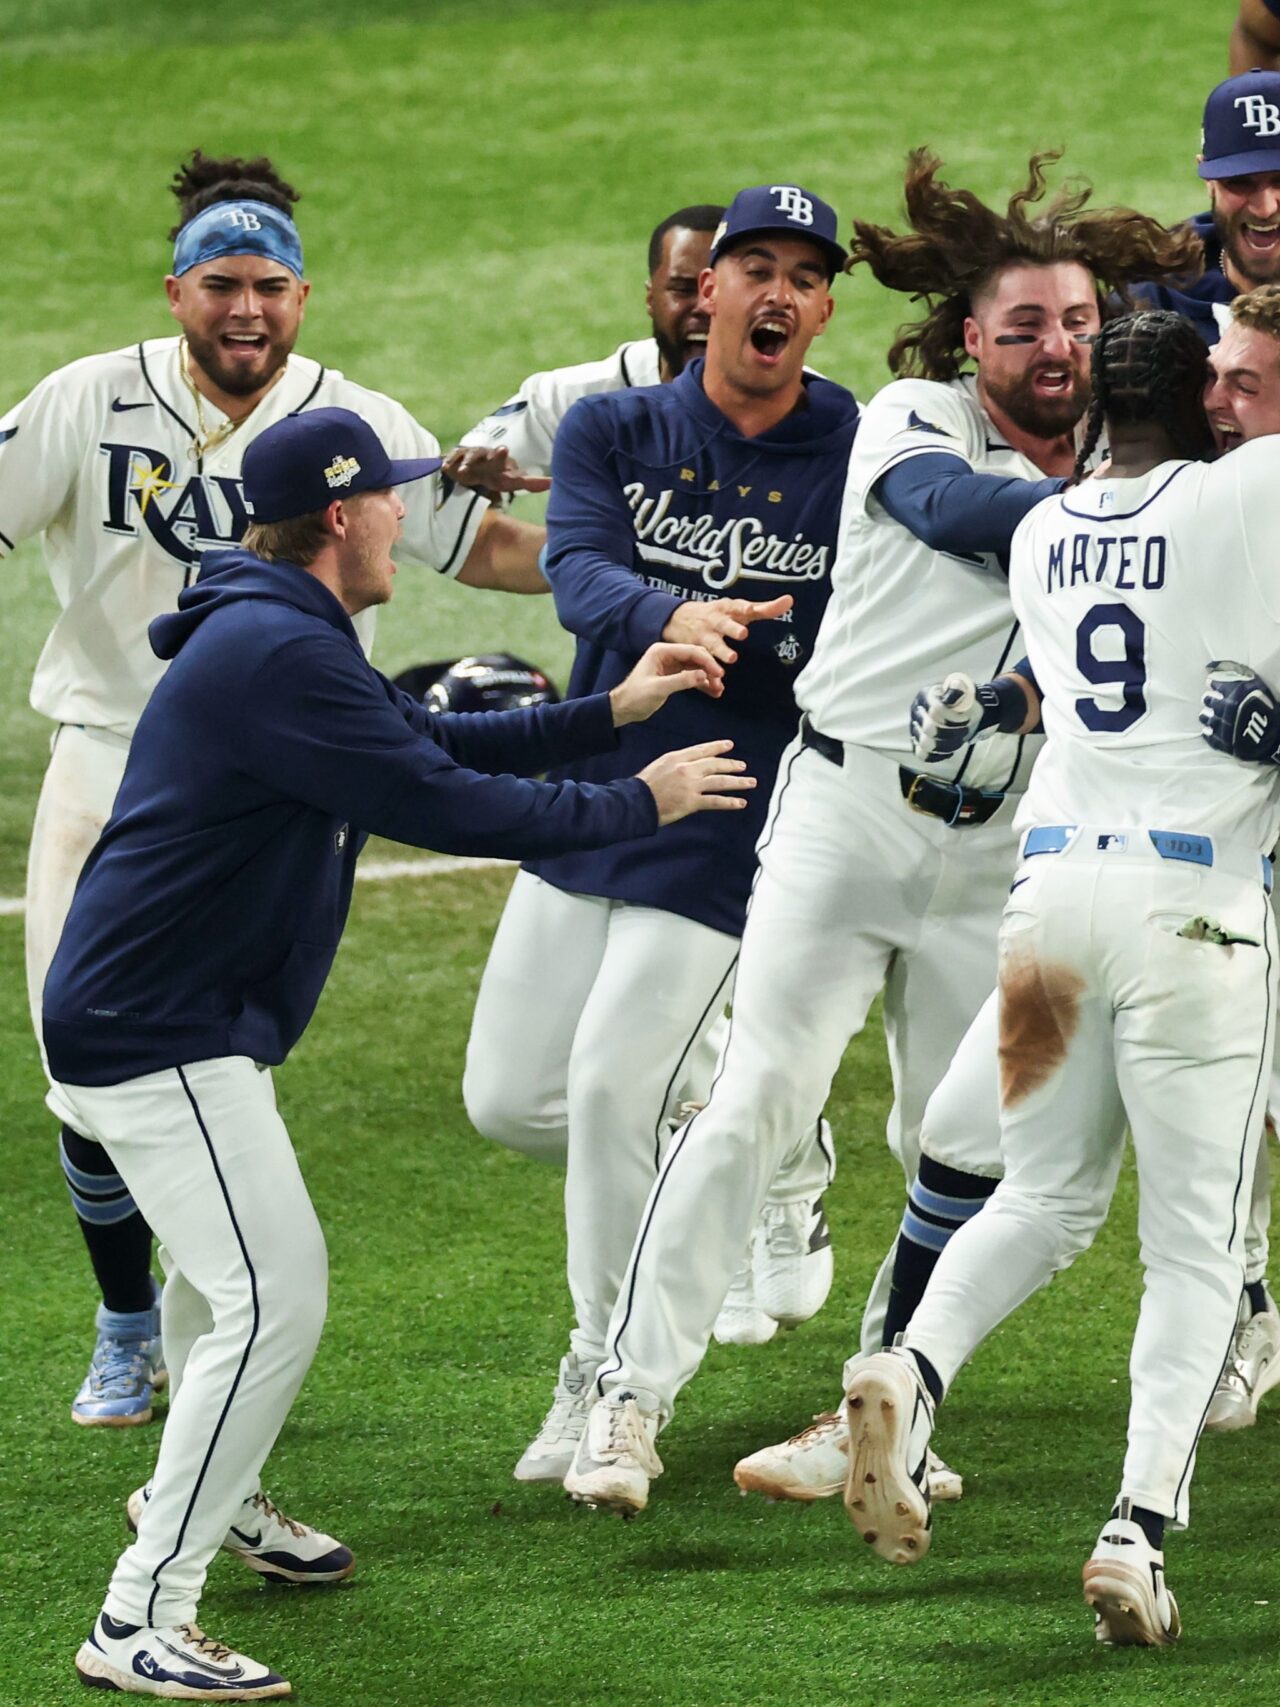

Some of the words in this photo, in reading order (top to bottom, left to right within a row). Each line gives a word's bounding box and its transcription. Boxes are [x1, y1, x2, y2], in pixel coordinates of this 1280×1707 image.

[221, 209, 261, 231] TB
[770, 186, 814, 226] TB
[680, 468, 782, 503] RAYS
[623, 482, 737, 562] World
[703, 517, 829, 589] Series
[1048, 534, 1166, 594] MATEO
[1075, 603, 1147, 732] 9
